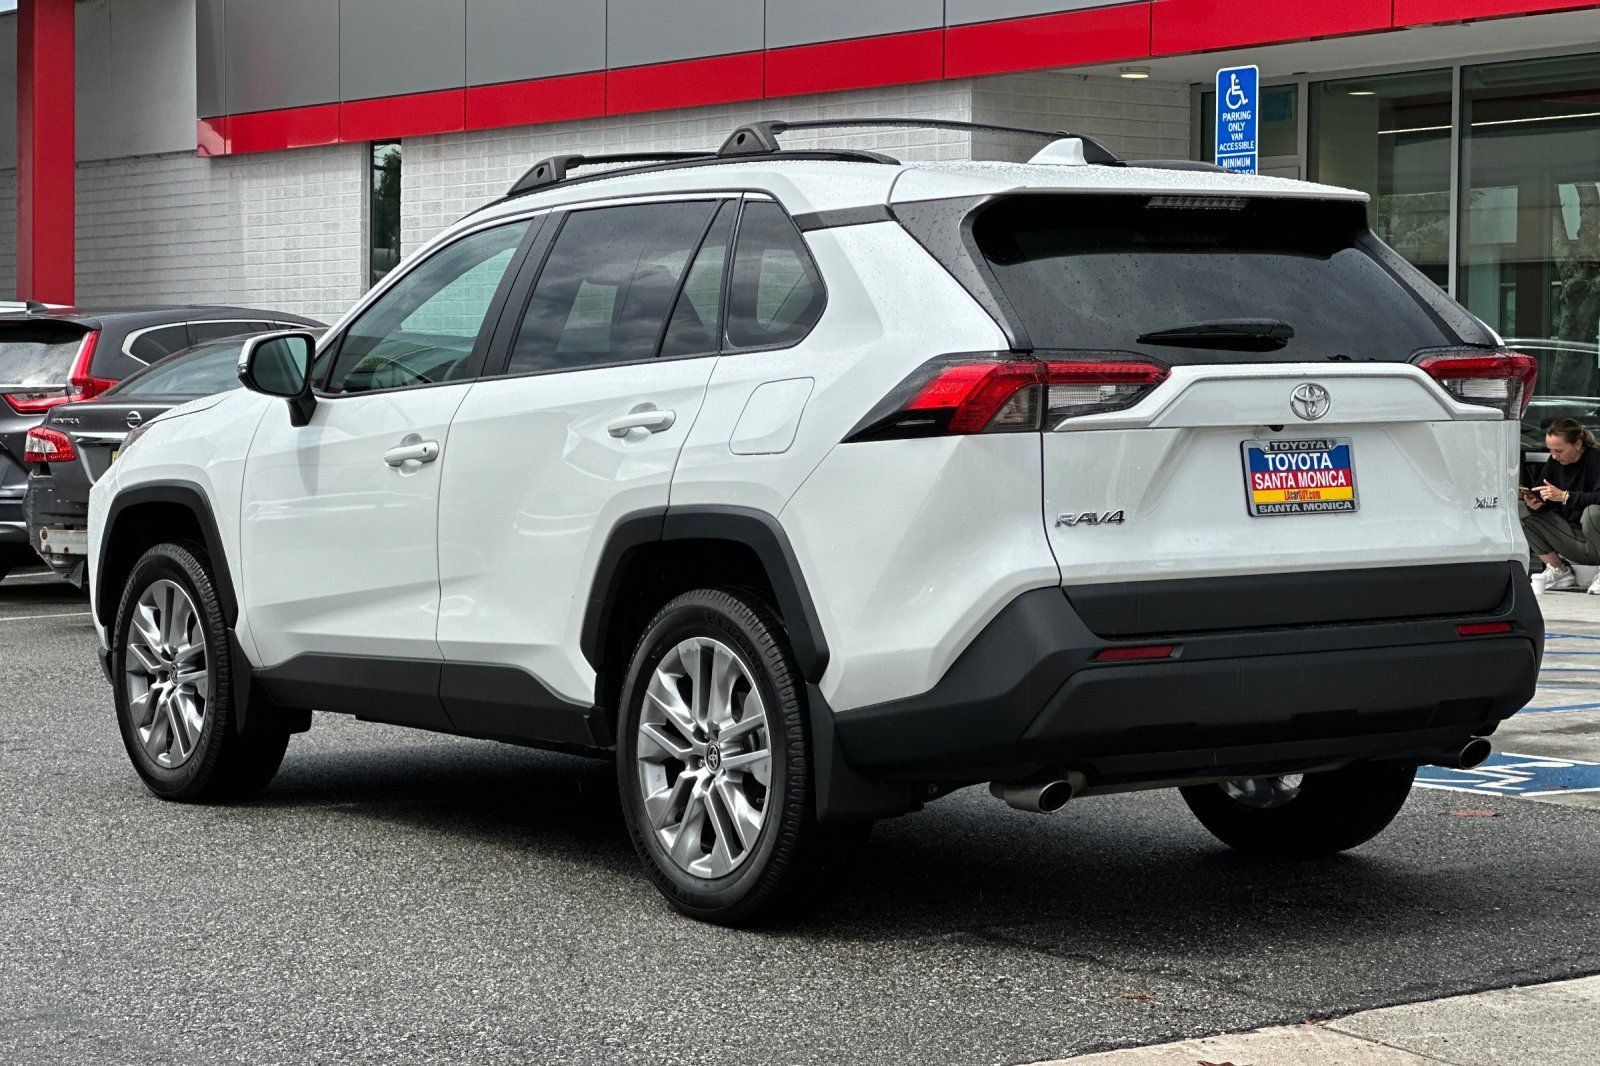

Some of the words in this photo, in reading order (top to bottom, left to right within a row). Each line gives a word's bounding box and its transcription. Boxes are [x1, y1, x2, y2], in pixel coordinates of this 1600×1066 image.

[1222, 110, 1251, 121] PARKING
[1228, 121, 1245, 131] ONLY
[1231, 132, 1243, 141] VAN
[1219, 140, 1254, 151] ACCESSIBLE
[1222, 156, 1250, 168] MINIMUM
[1271, 441, 1325, 450] TOYOTA
[1264, 452, 1333, 470] TOYOTA
[1255, 472, 1296, 489] SANTA
[1298, 470, 1346, 488] MONICA
[1259, 504, 1300, 513] SANTA
[1303, 501, 1352, 512] MONICA
[1055, 509, 1125, 528] RAV4
